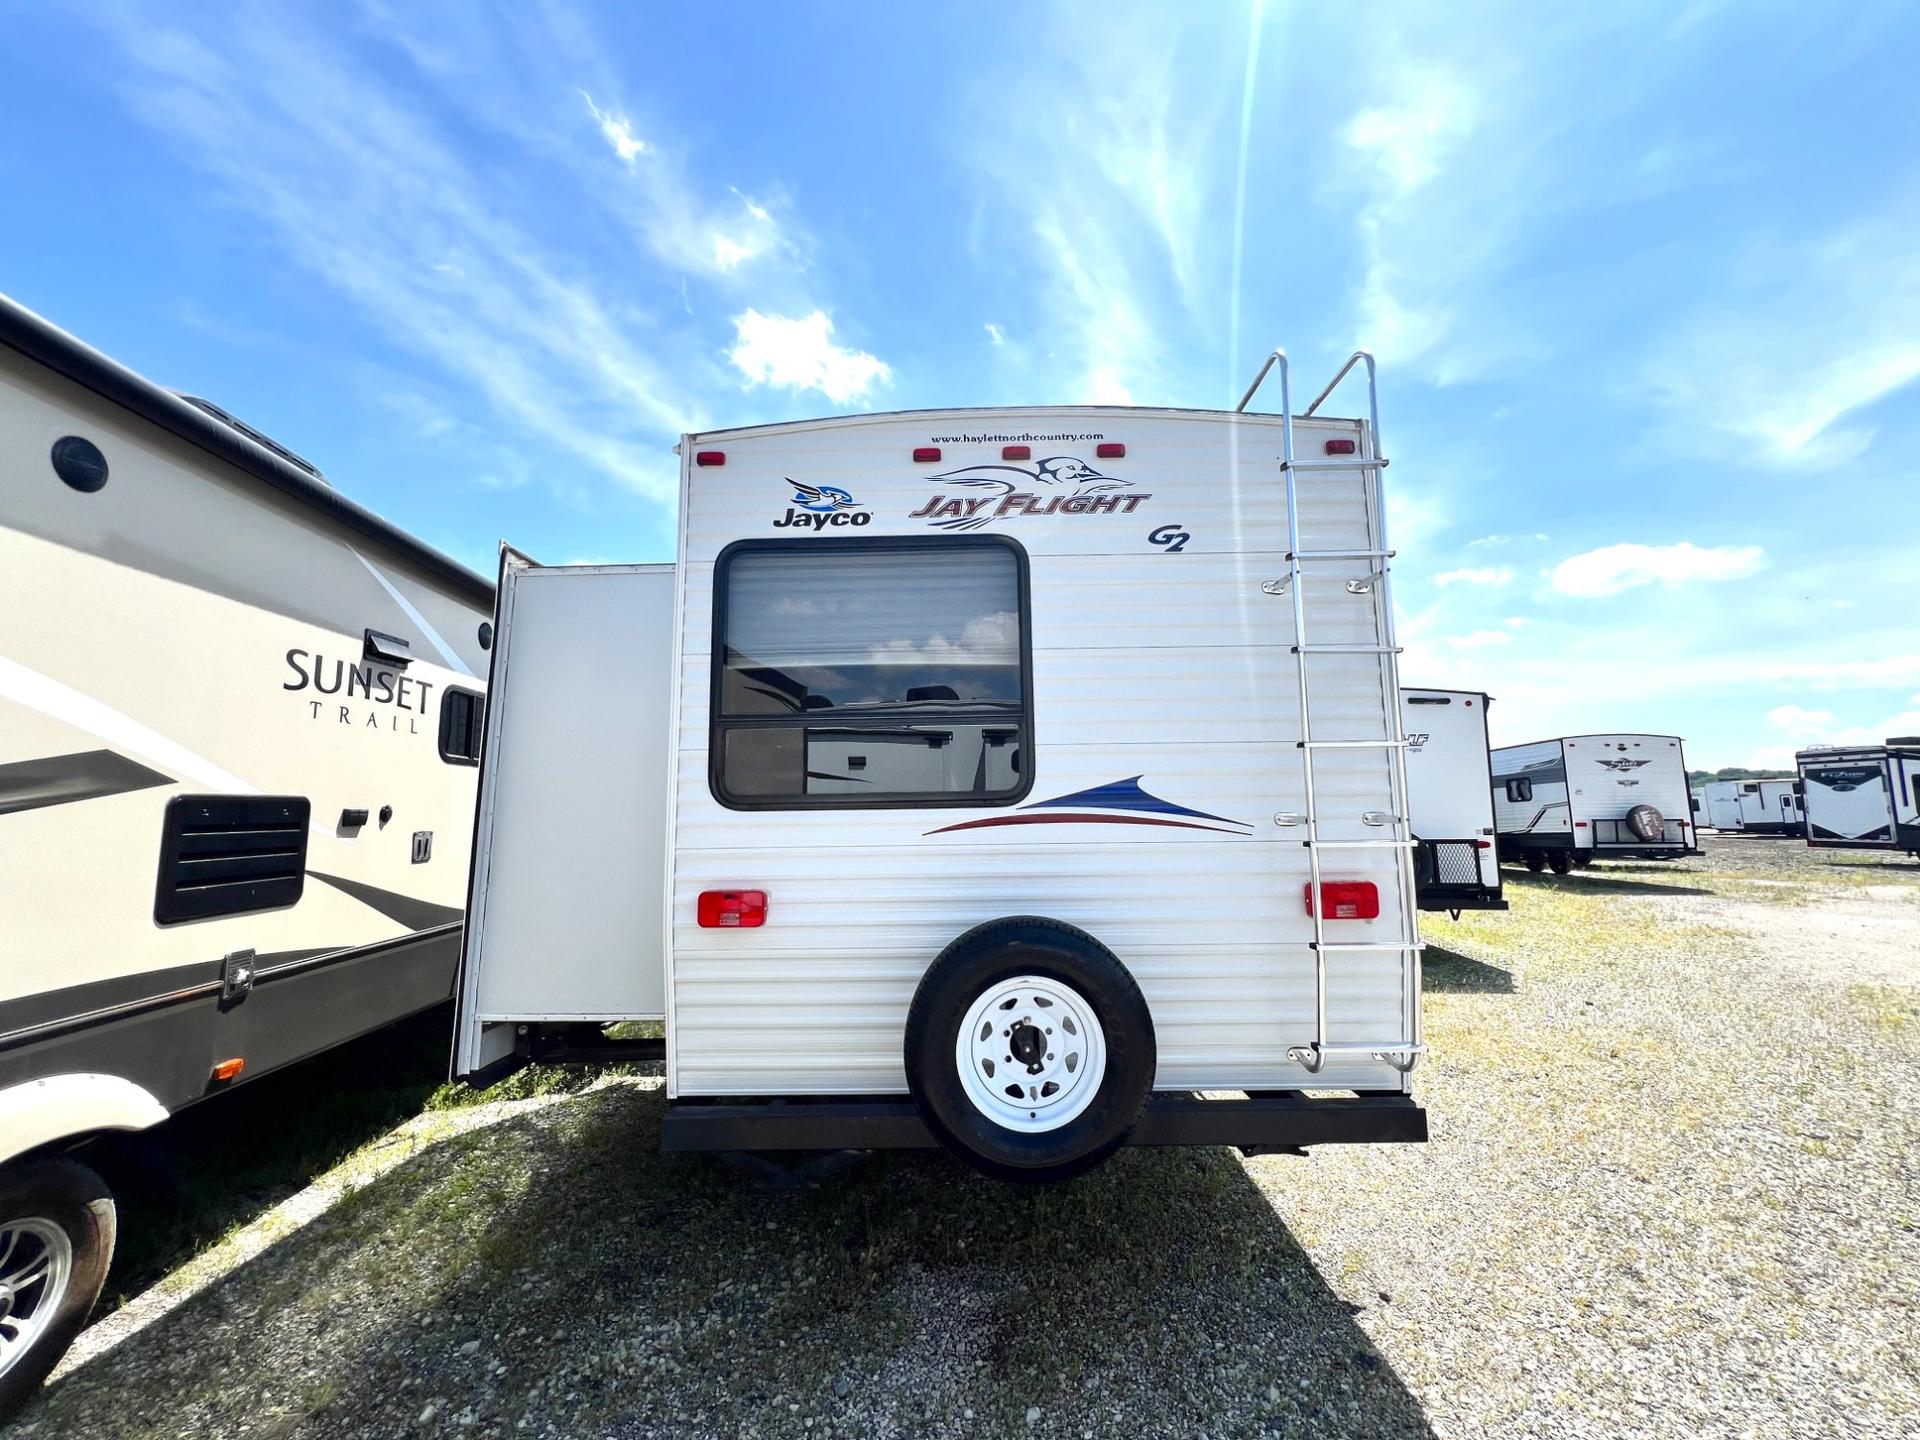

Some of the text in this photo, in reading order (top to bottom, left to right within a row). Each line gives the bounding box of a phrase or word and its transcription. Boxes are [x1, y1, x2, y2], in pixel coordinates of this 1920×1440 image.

[931, 432, 1104, 444] www.haylettnorthcountry.com
[909, 493, 1152, 518] JAY FLIGHT
[773, 508, 871, 531] Jayco
[1148, 524, 1190, 552] G2
[283, 648, 433, 714] SUNSET
[309, 700, 418, 734] TRAIL
